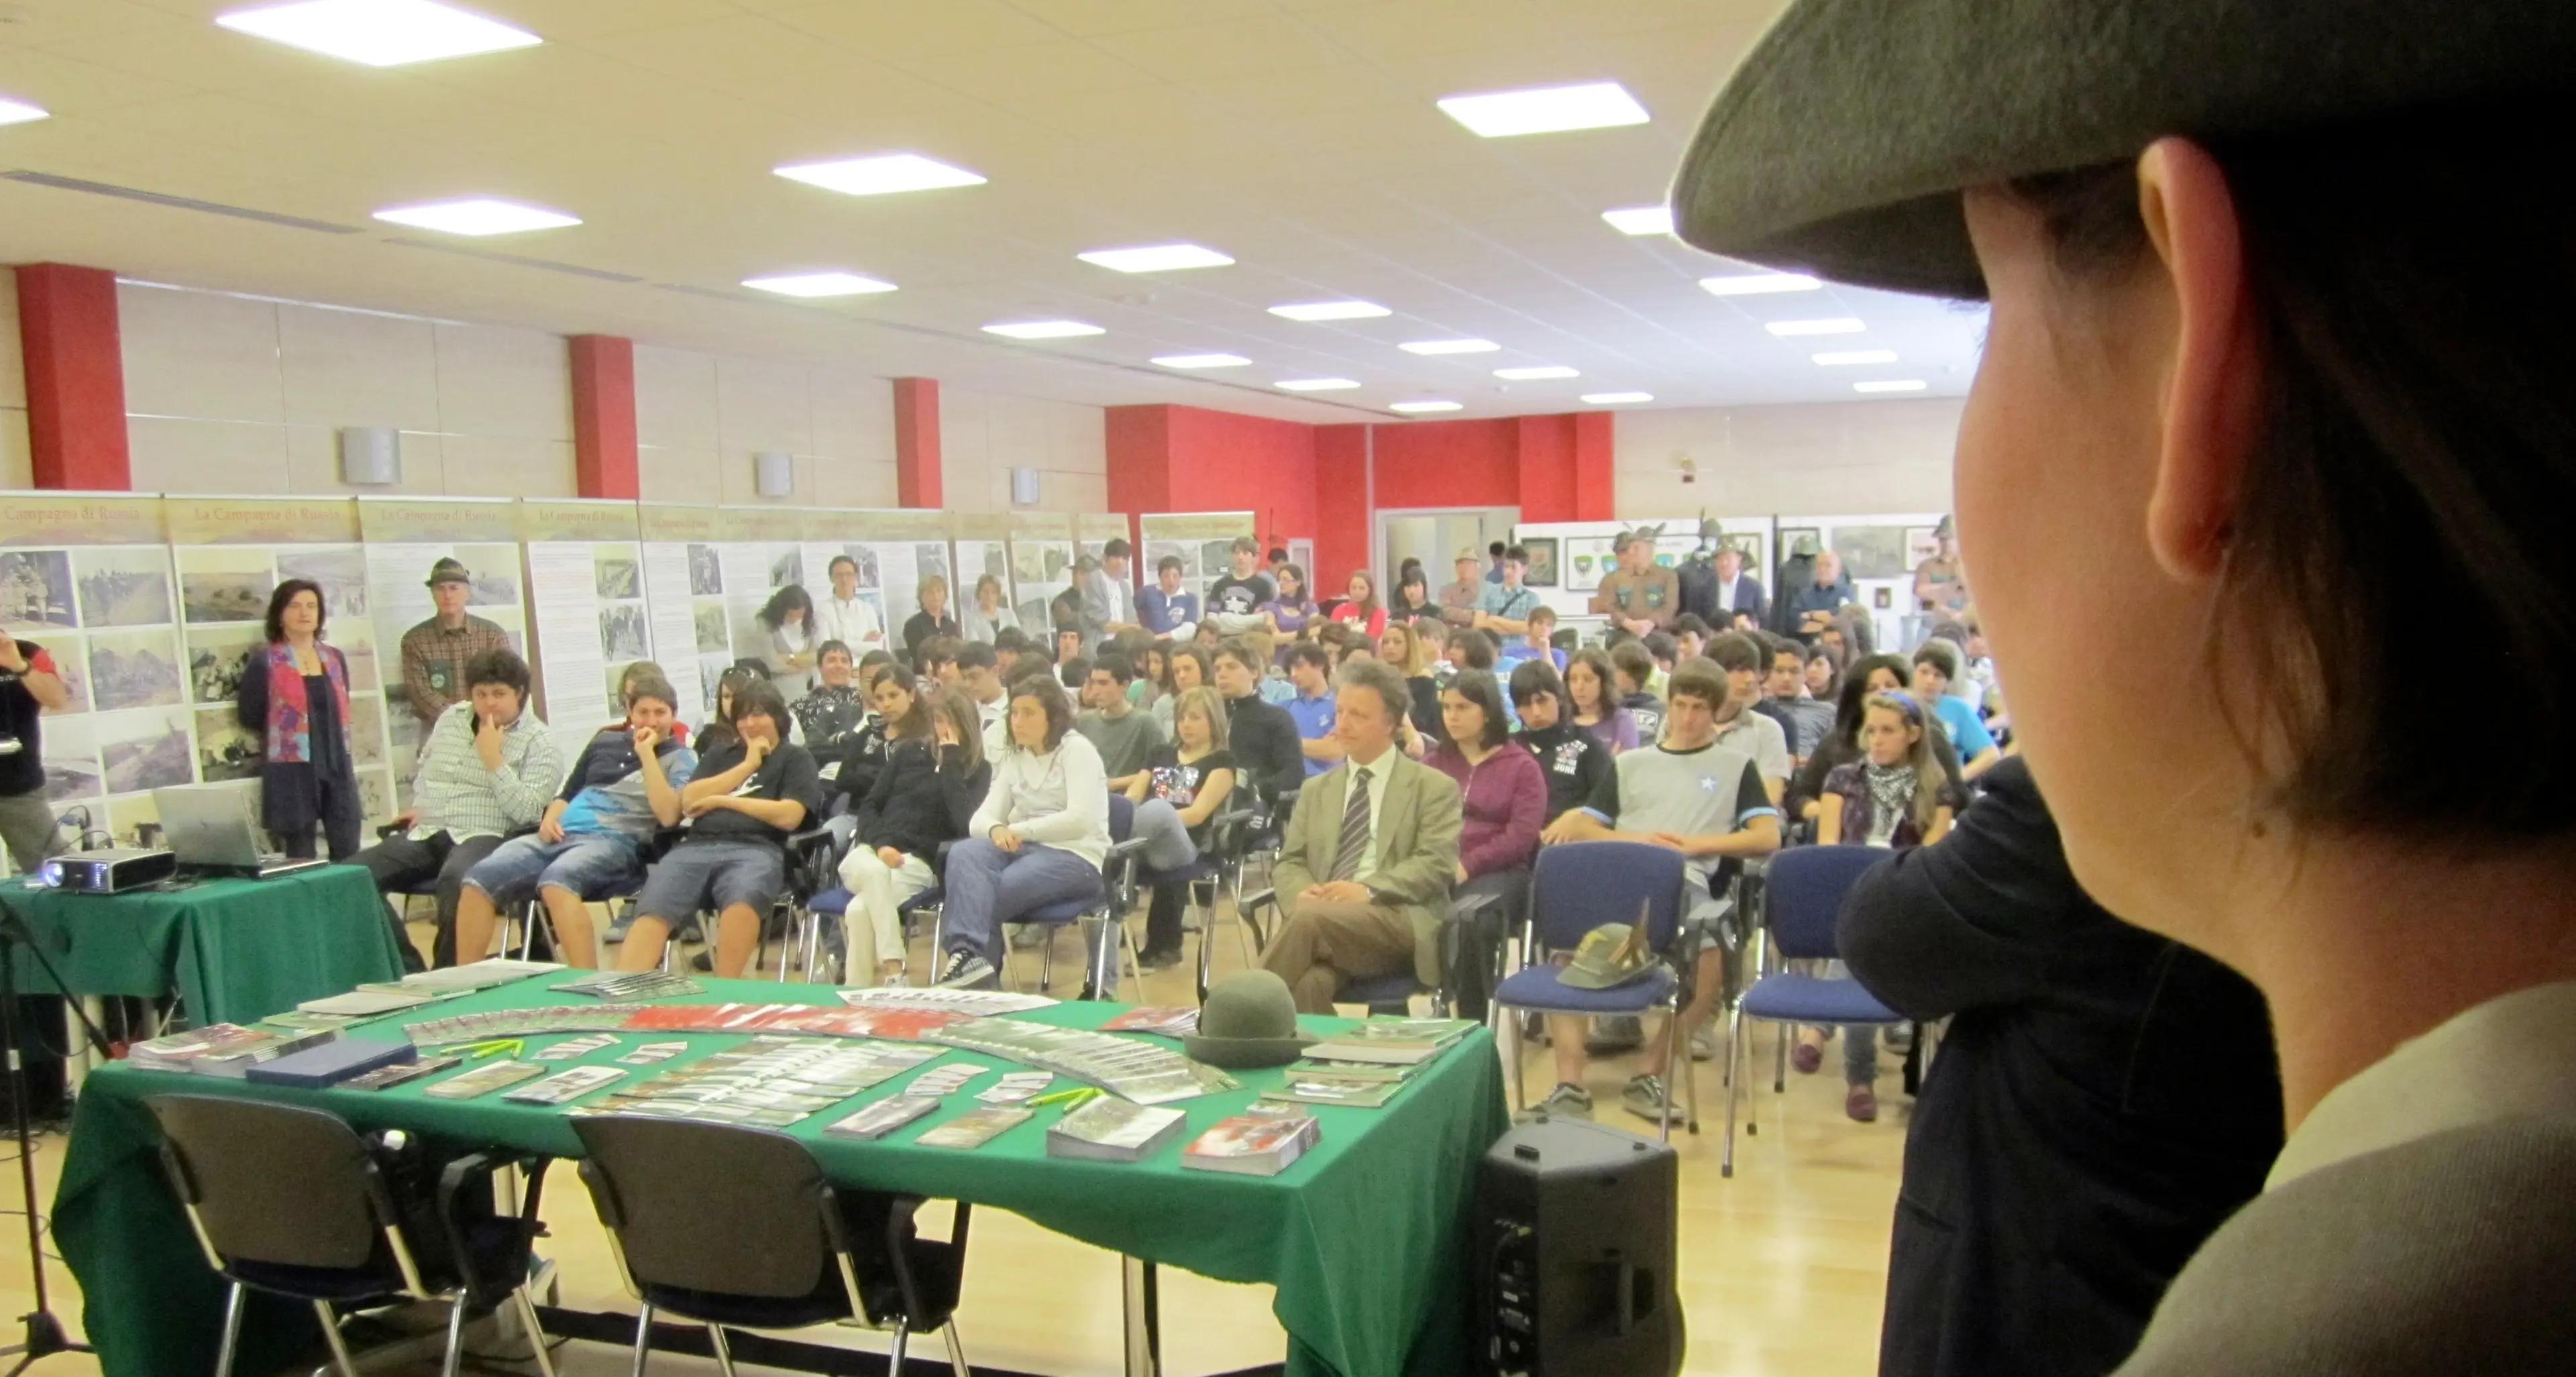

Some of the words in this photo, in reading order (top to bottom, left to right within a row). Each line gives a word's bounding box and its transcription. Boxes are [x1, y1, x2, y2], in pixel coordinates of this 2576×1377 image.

[5, 506, 77, 524] Campagna
[81, 506, 94, 520] di
[99, 506, 140, 520] Russia
[195, 507, 209, 520] La
[214, 507, 280, 525] Campagna
[285, 508, 297, 521] di
[300, 508, 340, 521] Russia
[381, 509, 393, 522] La
[397, 509, 449, 525] Campagna
[452, 510, 462, 522] di
